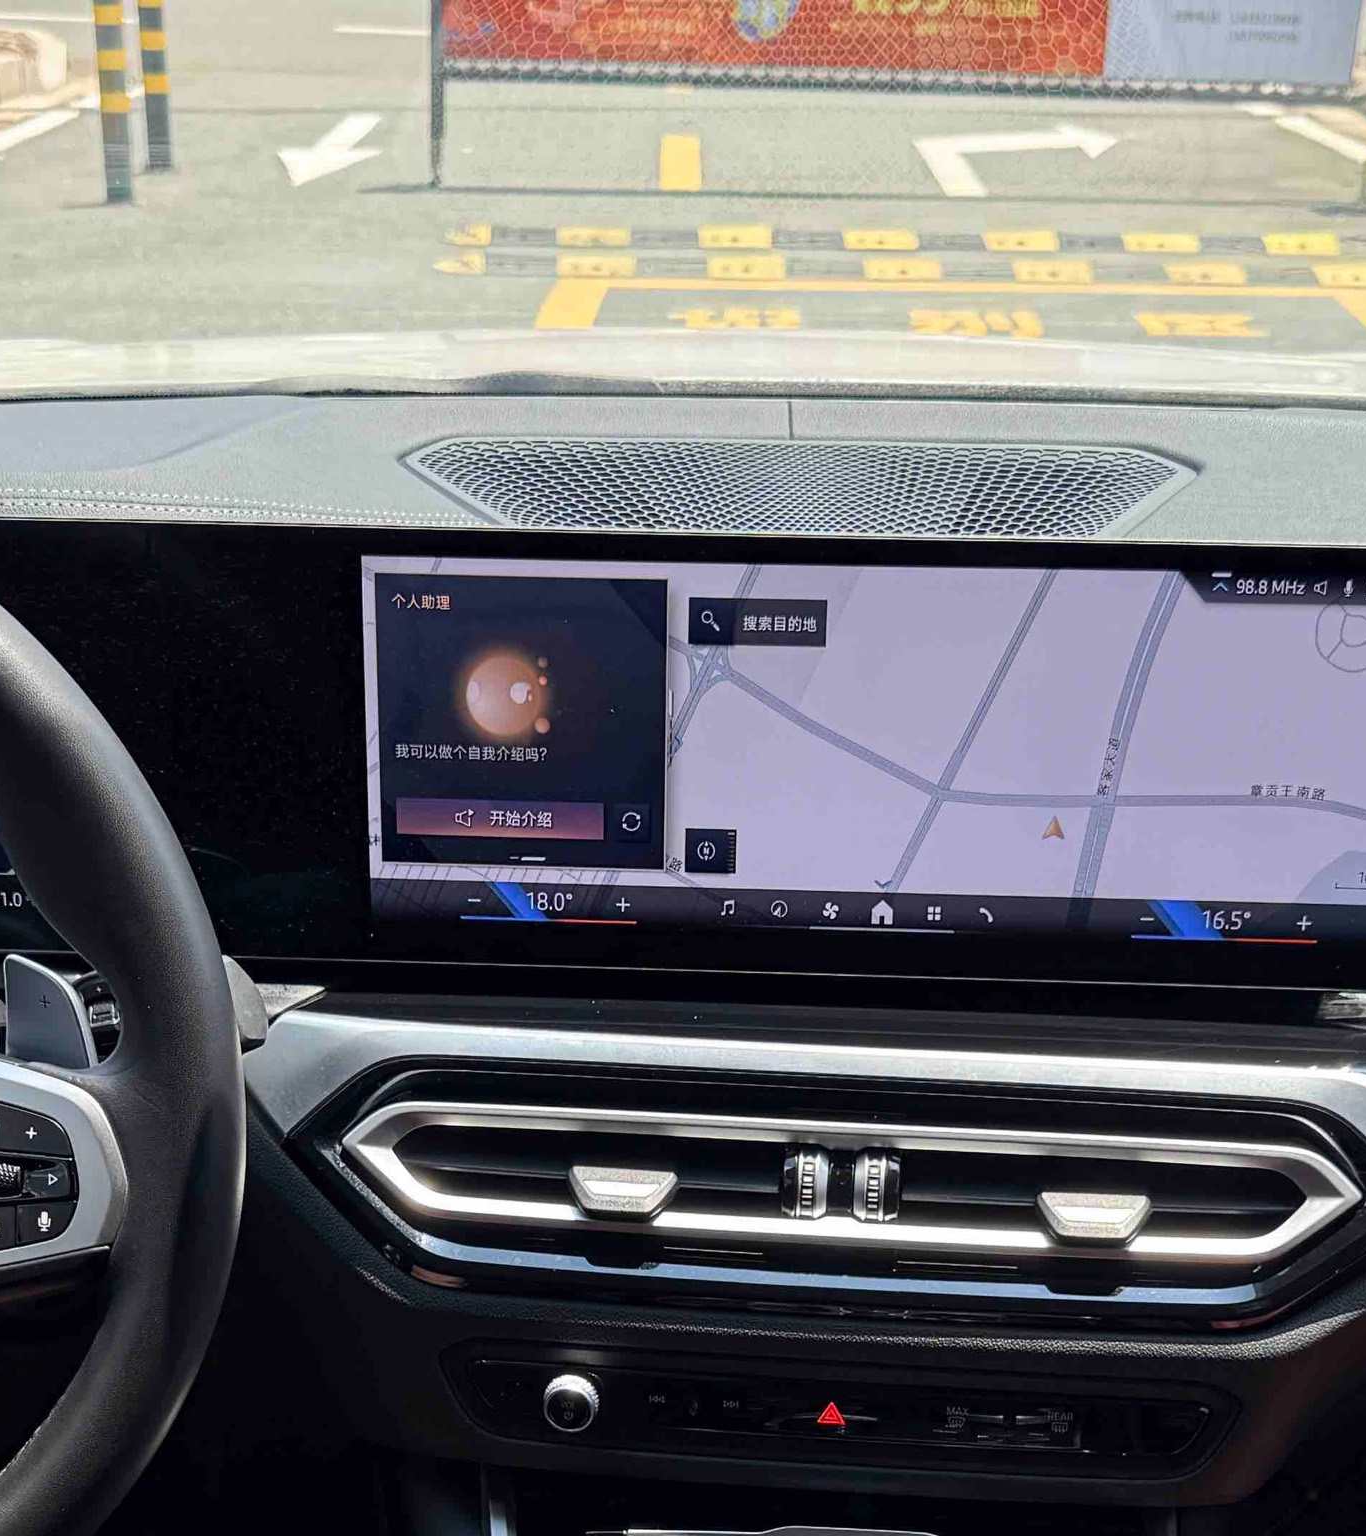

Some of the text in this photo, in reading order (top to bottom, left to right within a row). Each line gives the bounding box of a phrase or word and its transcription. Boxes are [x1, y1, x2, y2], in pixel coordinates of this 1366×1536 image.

[1236, 579, 1305, 595] 98.8 MHz
[391, 593, 451, 612] 个人助理
[742, 614, 818, 634] 搜索目的地
[489, 810, 553, 829] 开始介绍
[946, 1406, 970, 1416] MAX
[1047, 1411, 1074, 1422] REAR
